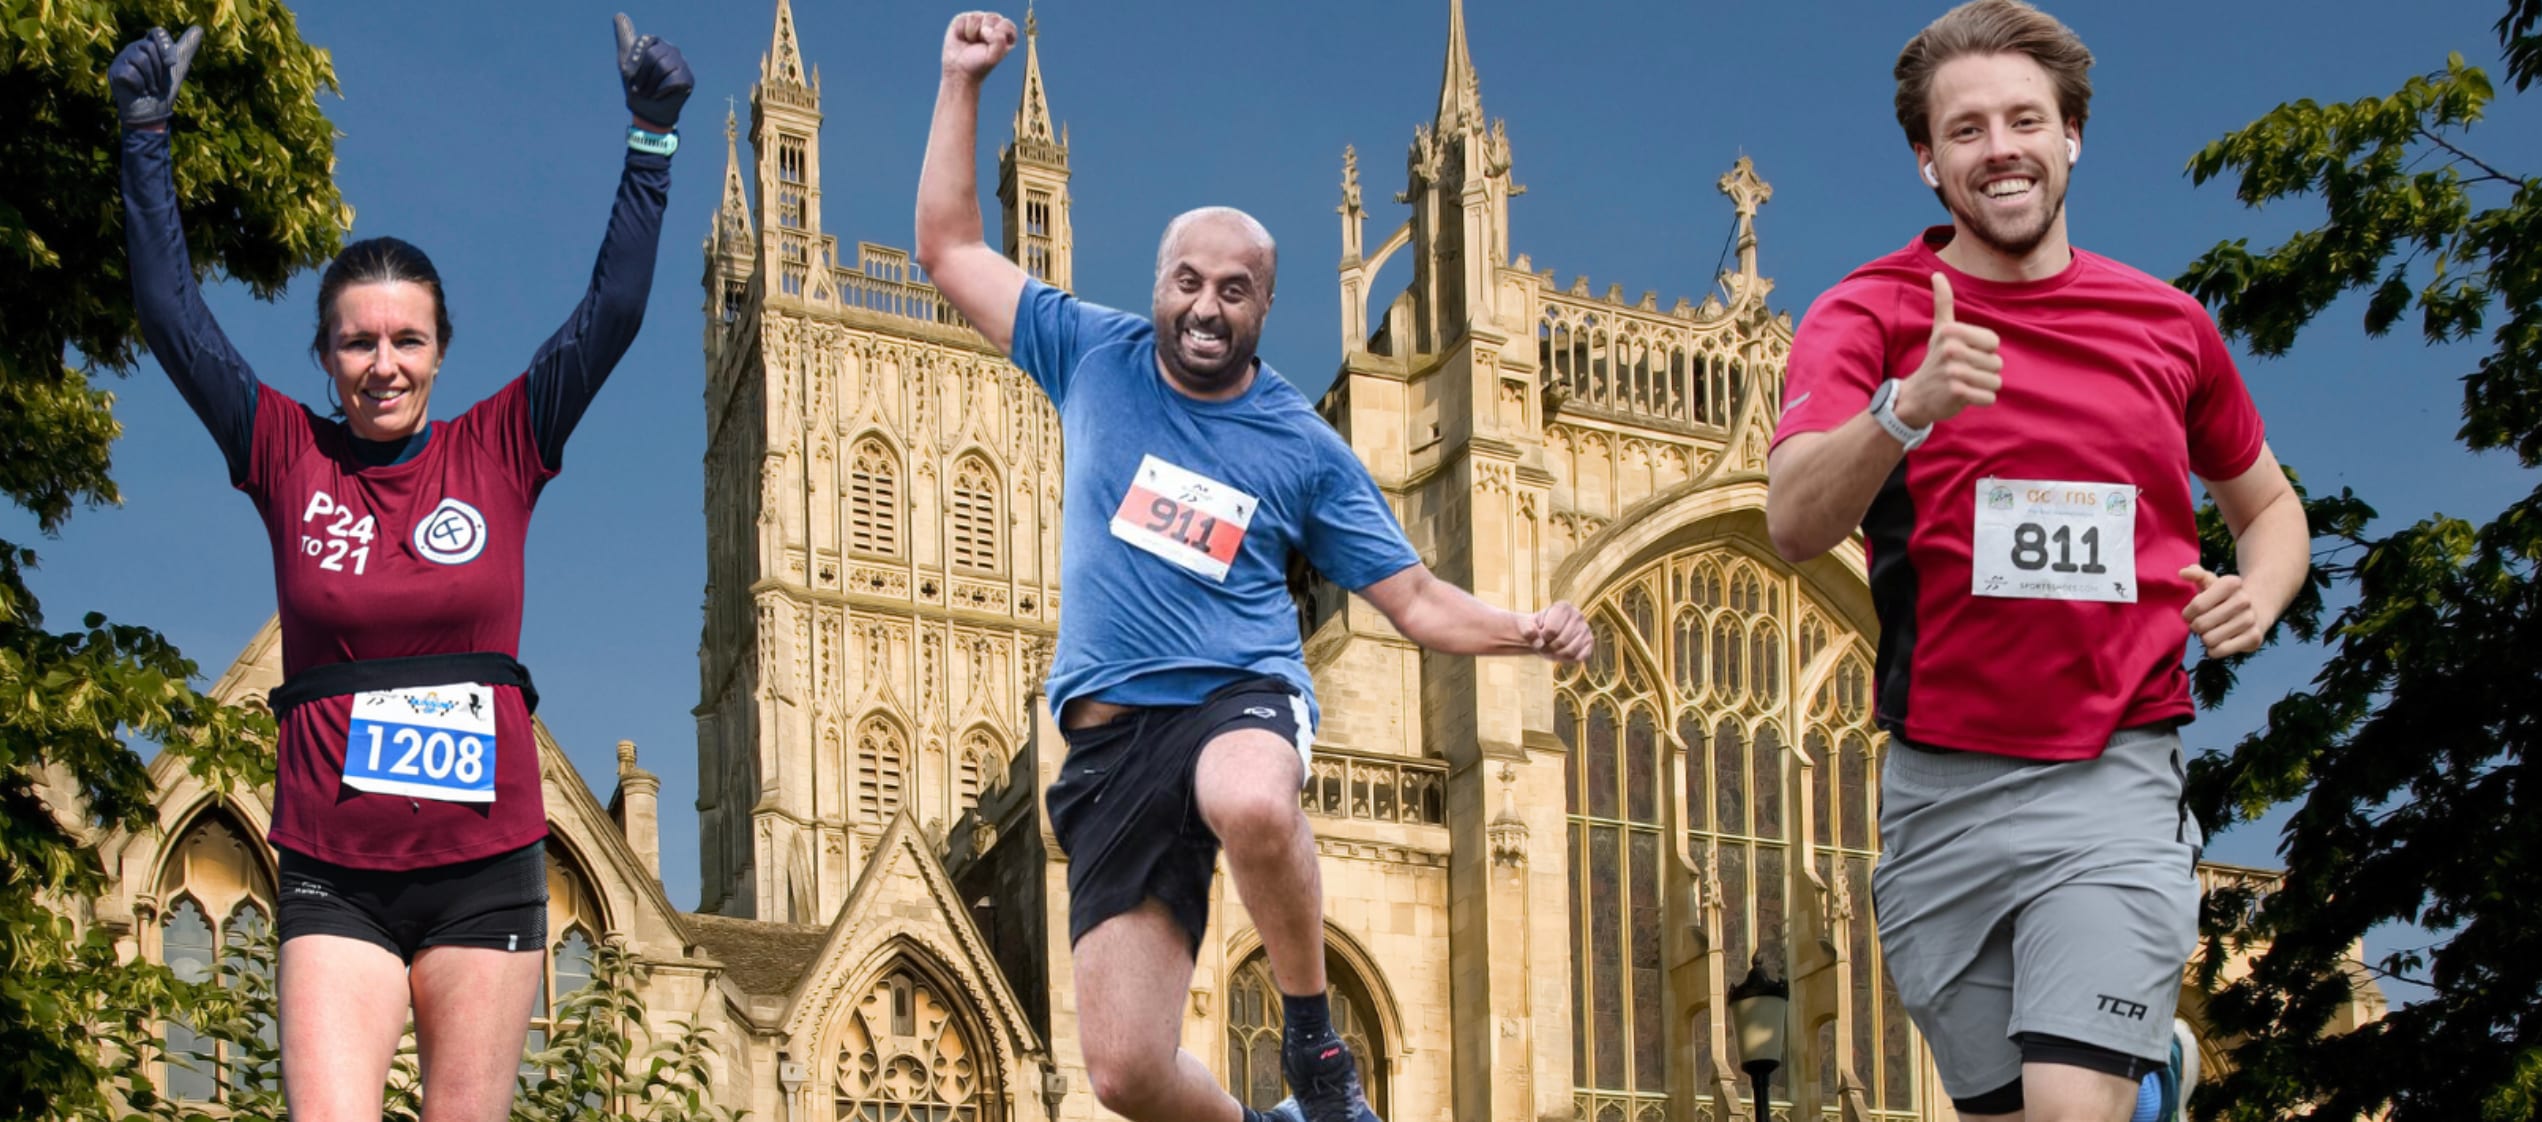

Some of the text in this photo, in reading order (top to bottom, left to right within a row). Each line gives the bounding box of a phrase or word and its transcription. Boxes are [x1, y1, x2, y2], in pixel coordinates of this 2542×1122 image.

[303, 490, 375, 544] P24
[1145, 497, 1216, 553] 911
[301, 536, 369, 575] TO 21
[2011, 522, 2107, 574] 811
[367, 725, 483, 784] 1208
[2097, 994, 2148, 1021] TCA
